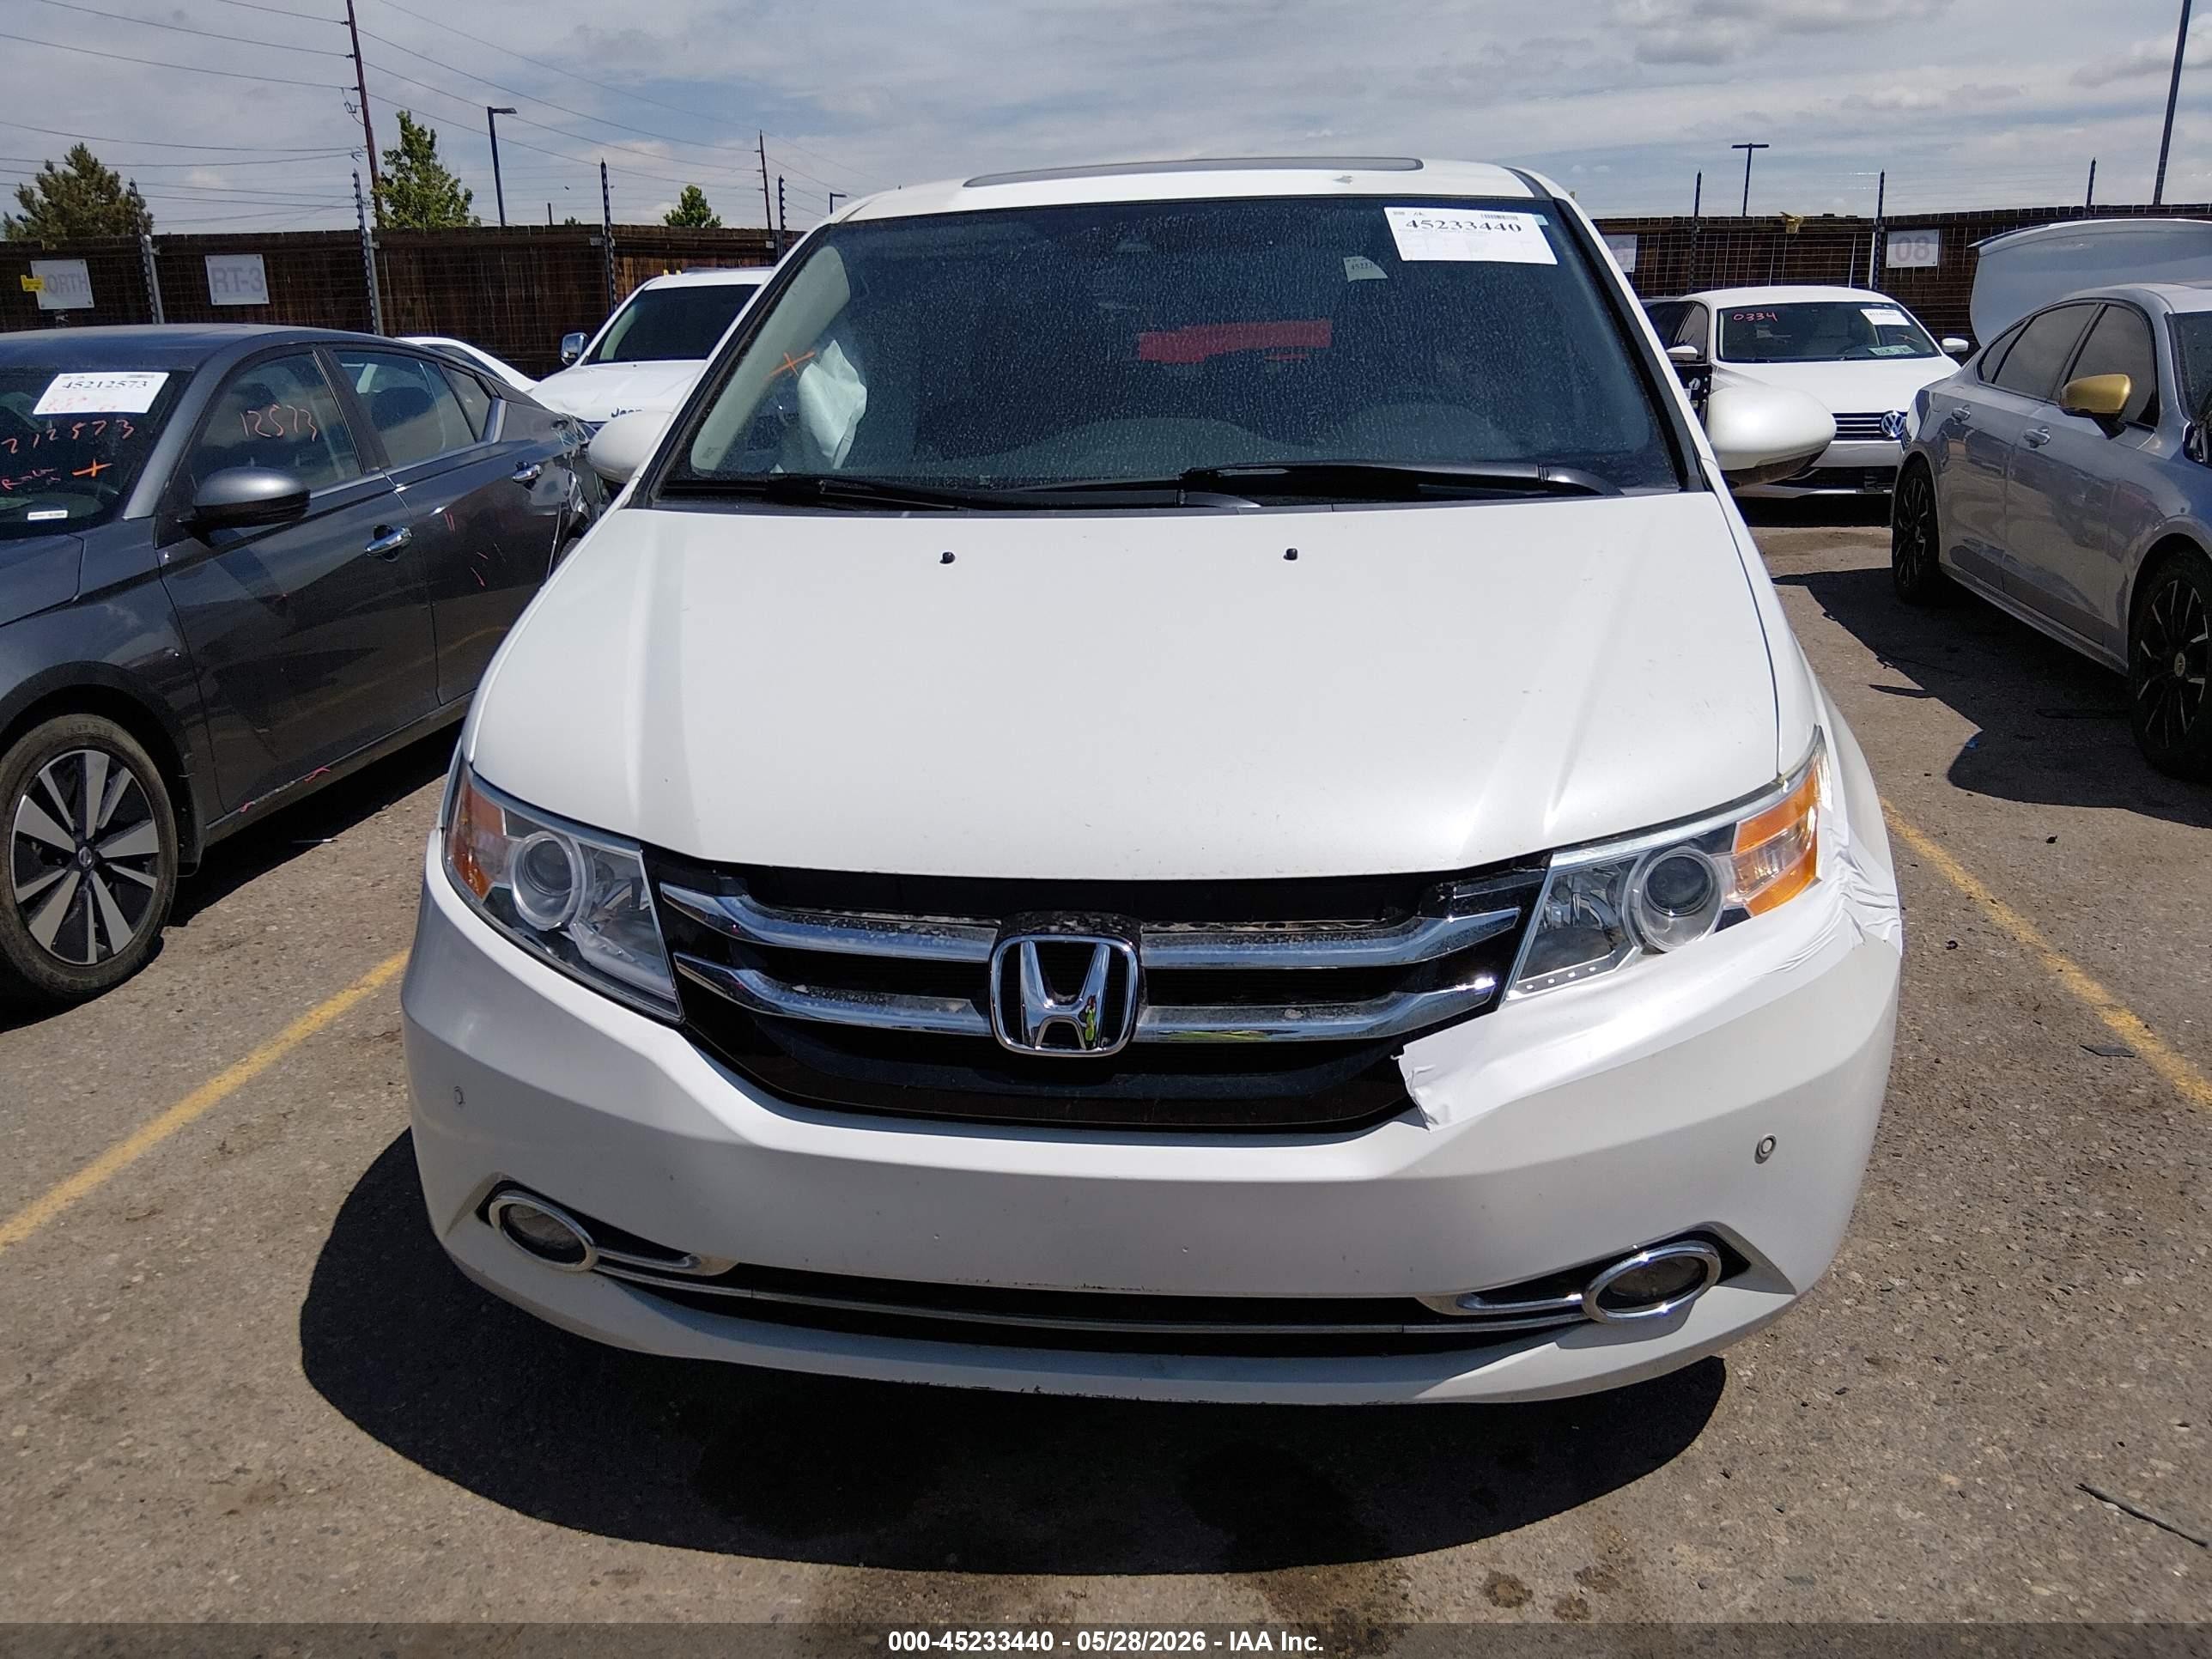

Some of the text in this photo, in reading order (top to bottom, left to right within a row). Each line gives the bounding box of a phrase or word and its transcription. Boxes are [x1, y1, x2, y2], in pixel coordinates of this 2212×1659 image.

[1406, 219, 1522, 233] 45233440
[43, 273, 90, 295] ORTH
[210, 267, 263, 293] RT-3
[62, 380, 148, 389] 45212573
[611, 406, 643, 418] Je
[240, 404, 318, 442] 12573
